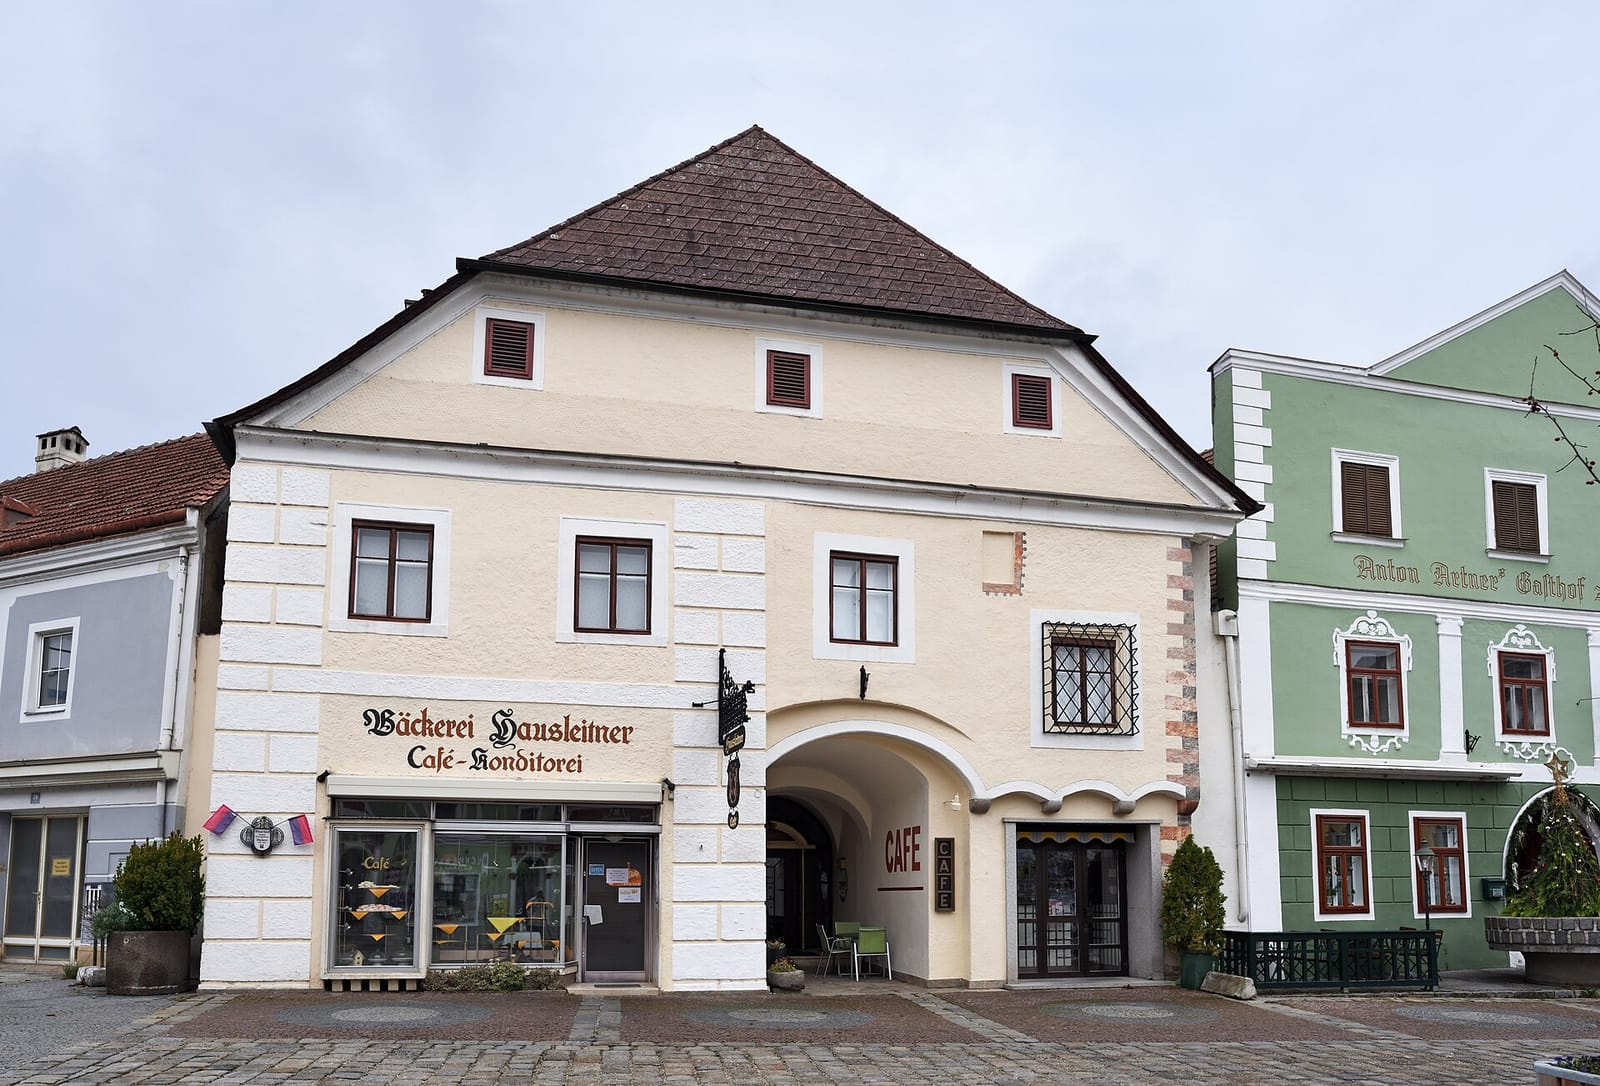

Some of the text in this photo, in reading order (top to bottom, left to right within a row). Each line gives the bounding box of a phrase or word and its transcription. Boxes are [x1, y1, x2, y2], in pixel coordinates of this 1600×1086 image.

[1353, 554, 1420, 584] Anton
[362, 707, 634, 749] Bäckerei Hausleitner
[364, 856, 390, 871] Café
[885, 825, 921, 874] CAFE
[939, 842, 950, 907] CAFE
